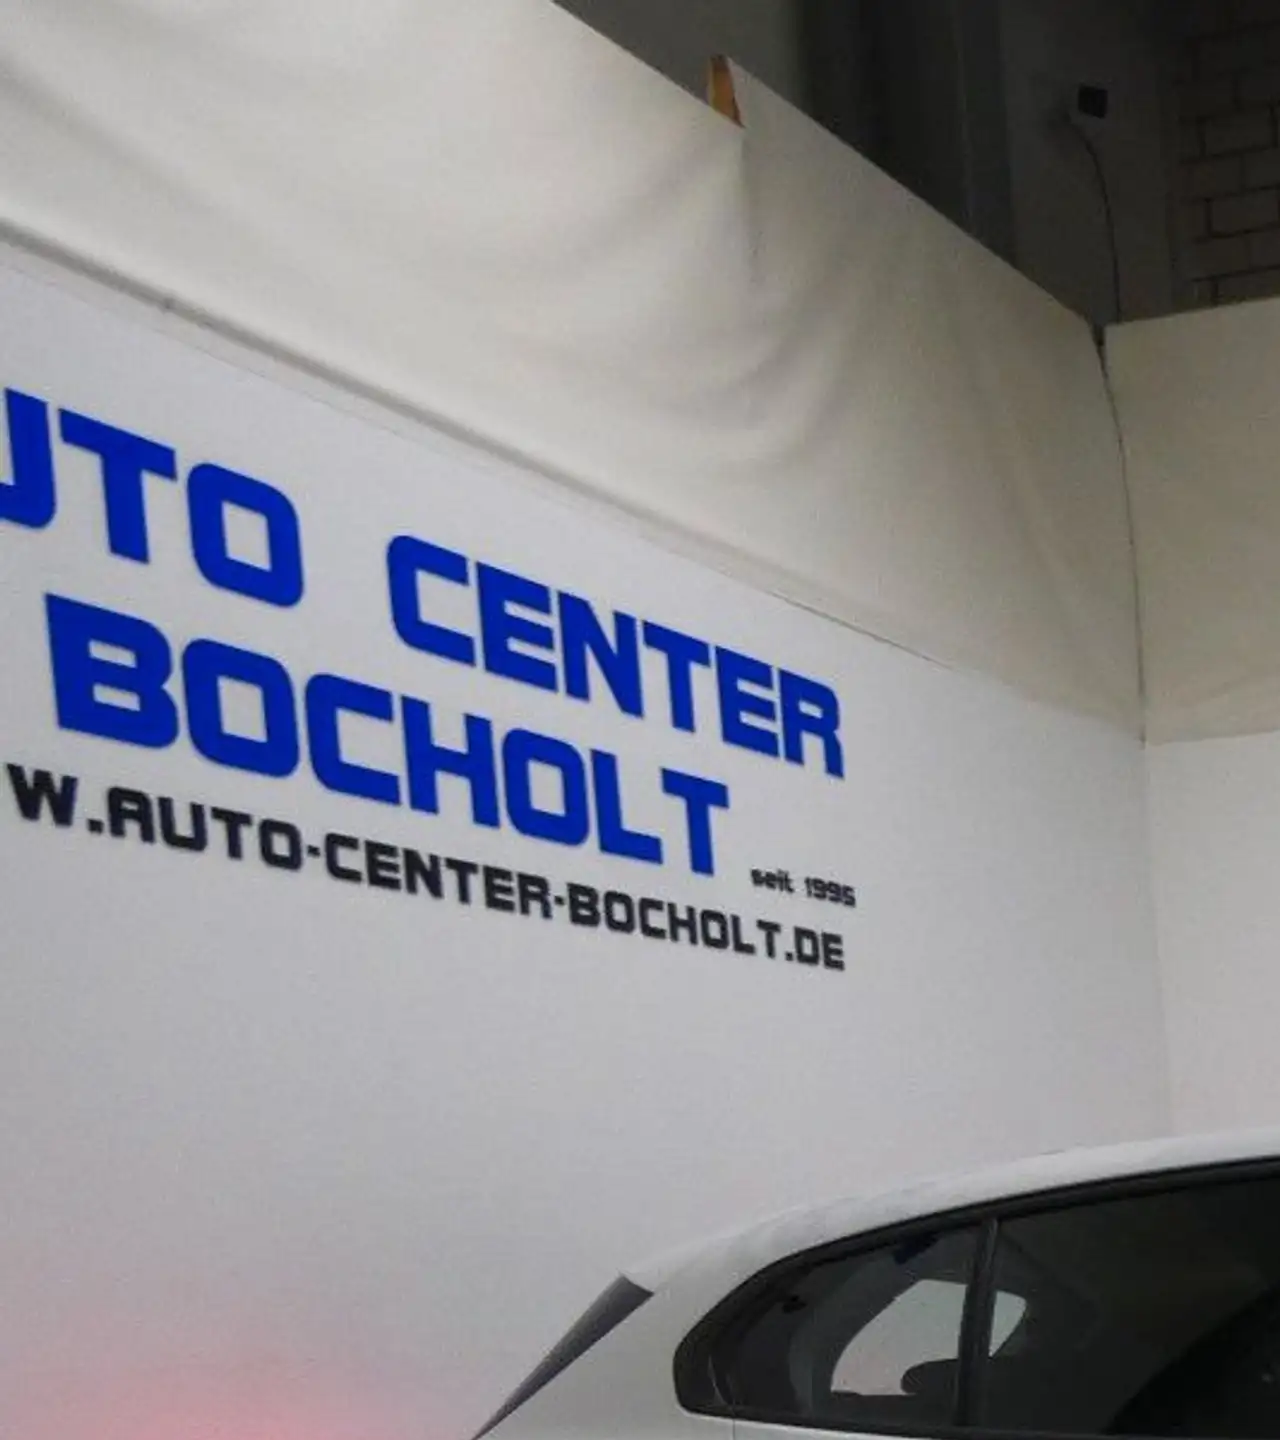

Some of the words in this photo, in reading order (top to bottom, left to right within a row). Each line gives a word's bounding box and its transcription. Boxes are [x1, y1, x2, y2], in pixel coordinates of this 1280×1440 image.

[43, 593, 731, 876] BOCHOLT
[750, 867, 795, 894] seit
[804, 876, 857, 909] 1995
[386, 533, 846, 778] CENTER
